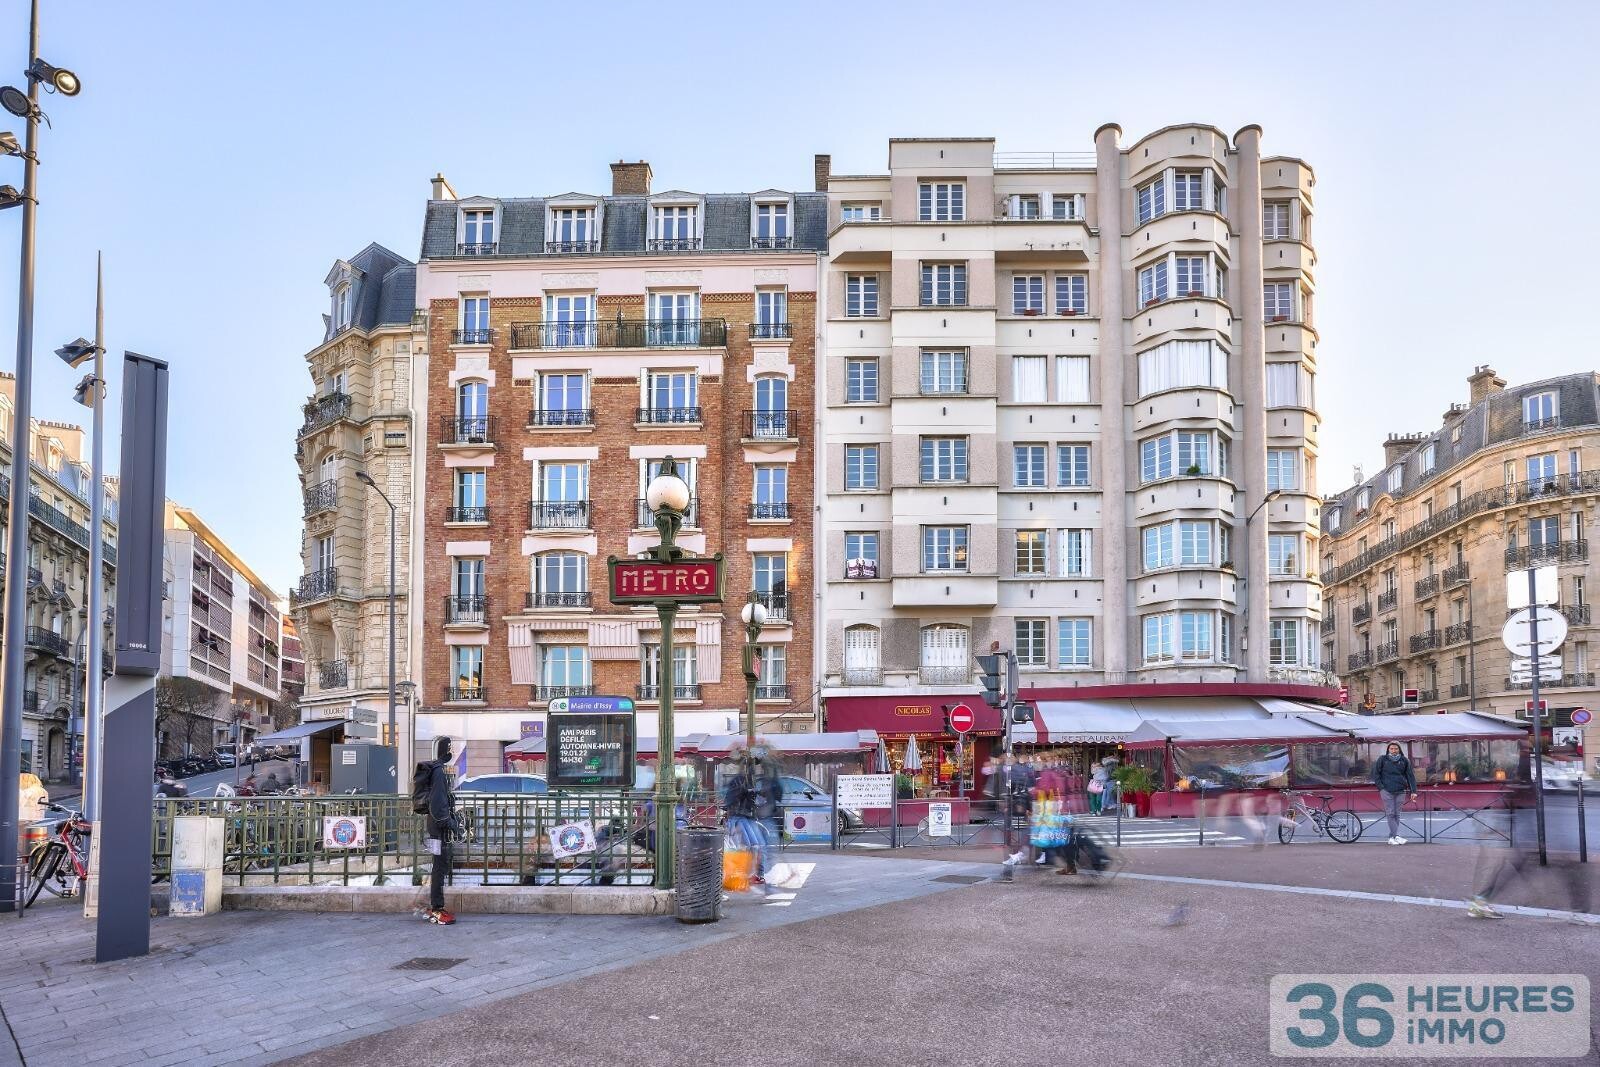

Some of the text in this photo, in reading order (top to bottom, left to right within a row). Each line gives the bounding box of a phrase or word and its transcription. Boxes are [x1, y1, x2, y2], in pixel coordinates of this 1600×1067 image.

[622, 569, 710, 591] METRO
[593, 702, 612, 710] d'Issy
[897, 707, 930, 715] NICOLAS
